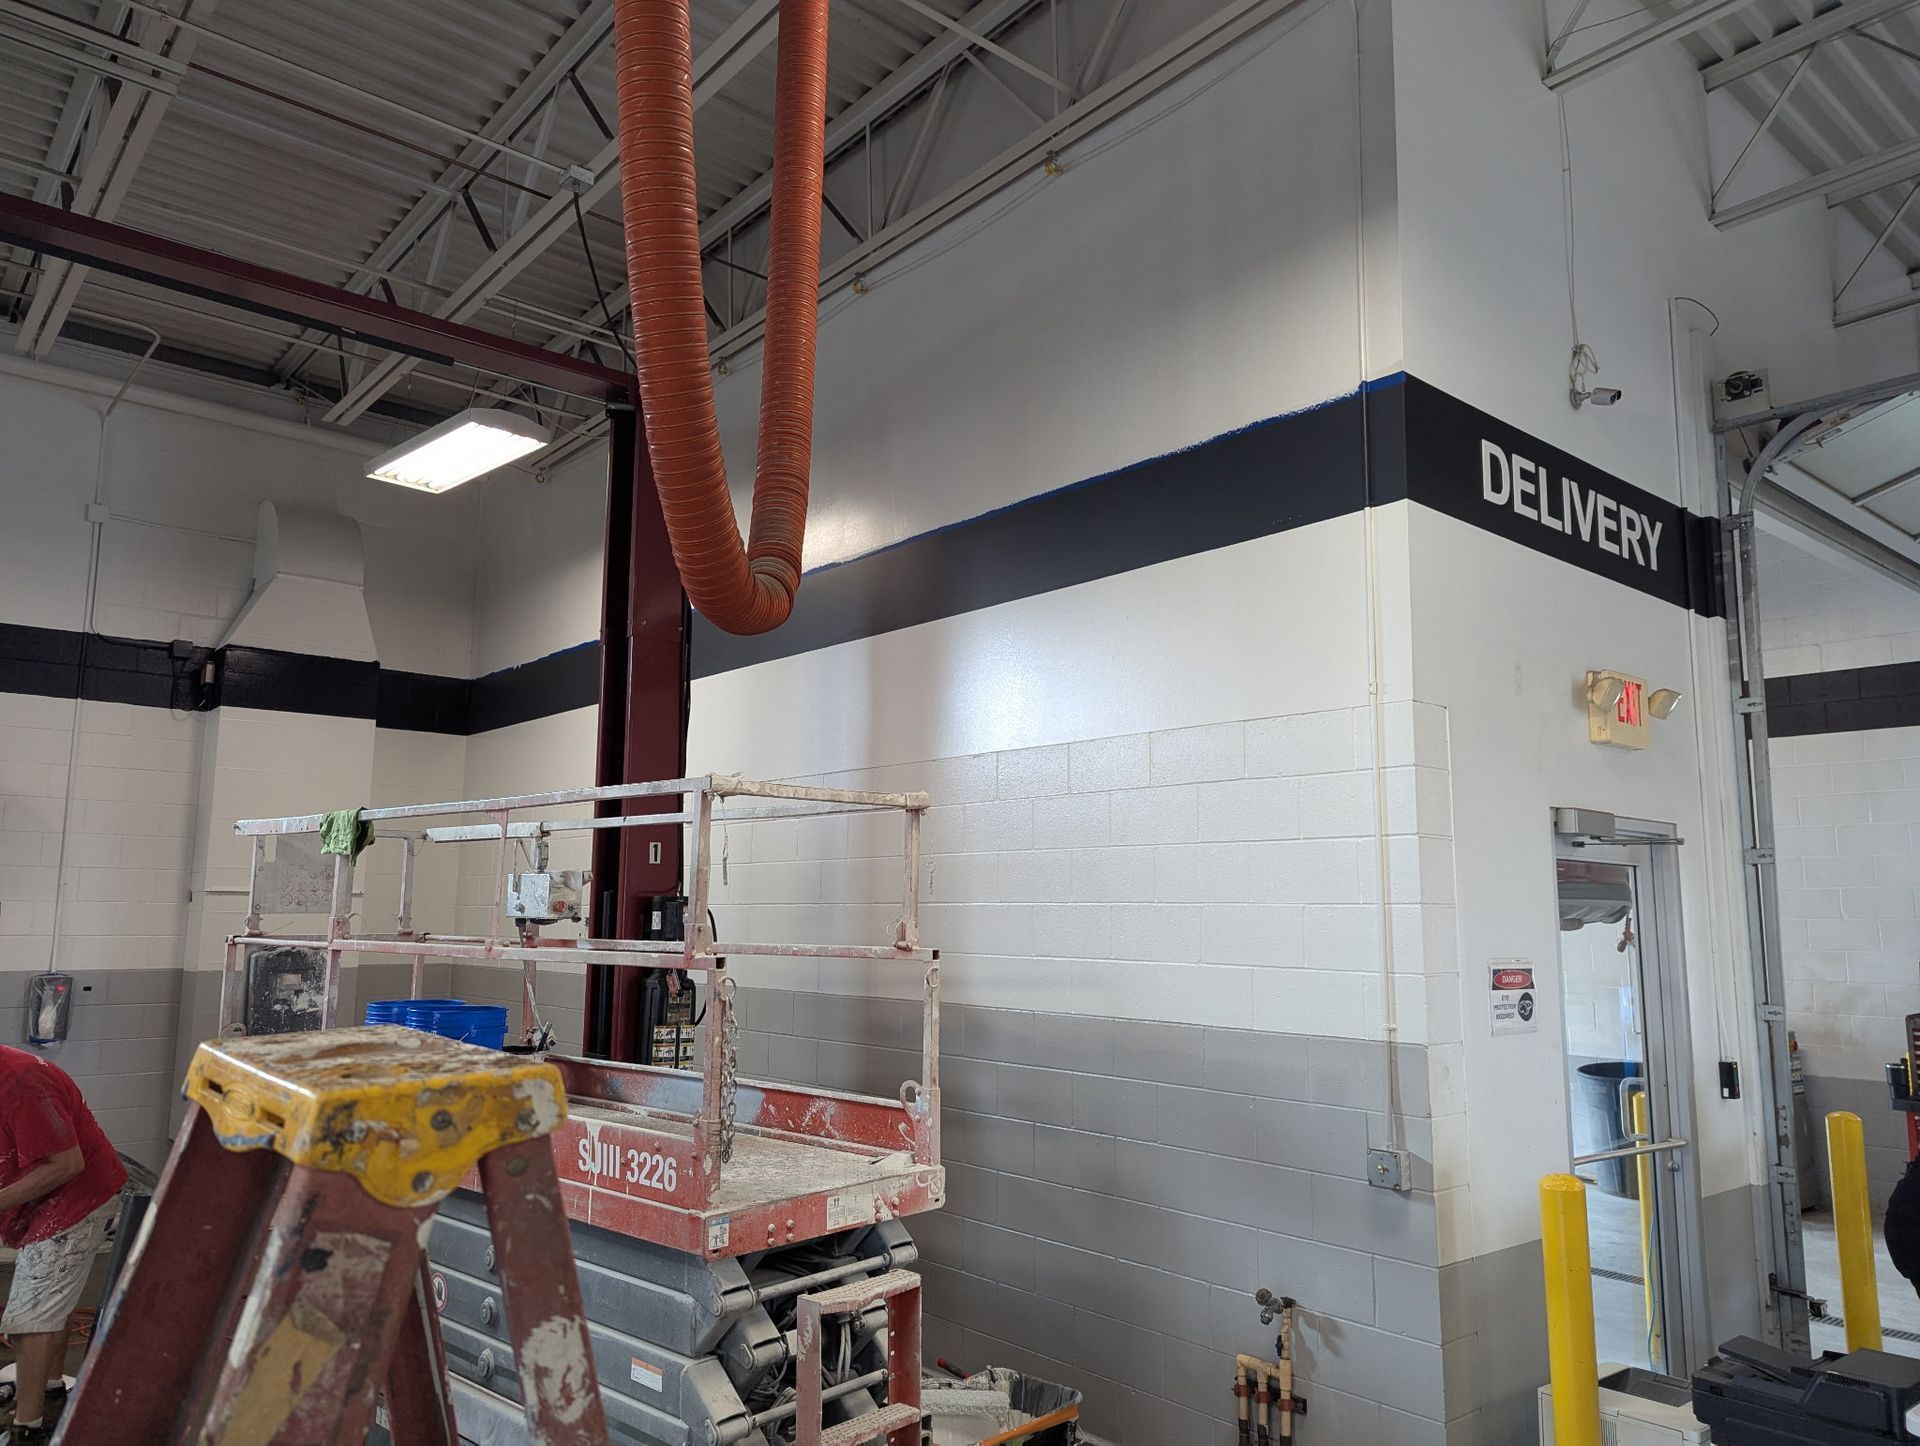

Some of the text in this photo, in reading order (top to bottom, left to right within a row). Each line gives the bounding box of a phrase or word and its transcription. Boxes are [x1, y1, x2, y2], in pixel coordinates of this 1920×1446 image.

[1481, 438, 1663, 571] DELIVERY
[1617, 679, 1642, 727] EXIT
[652, 843, 659, 862] 1
[1501, 975, 1523, 984] DANGER
[1493, 1003, 1517, 1011] PROTECTION
[1495, 1012, 1515, 1020] REQUIRED
[626, 1148, 677, 1193] 3226
